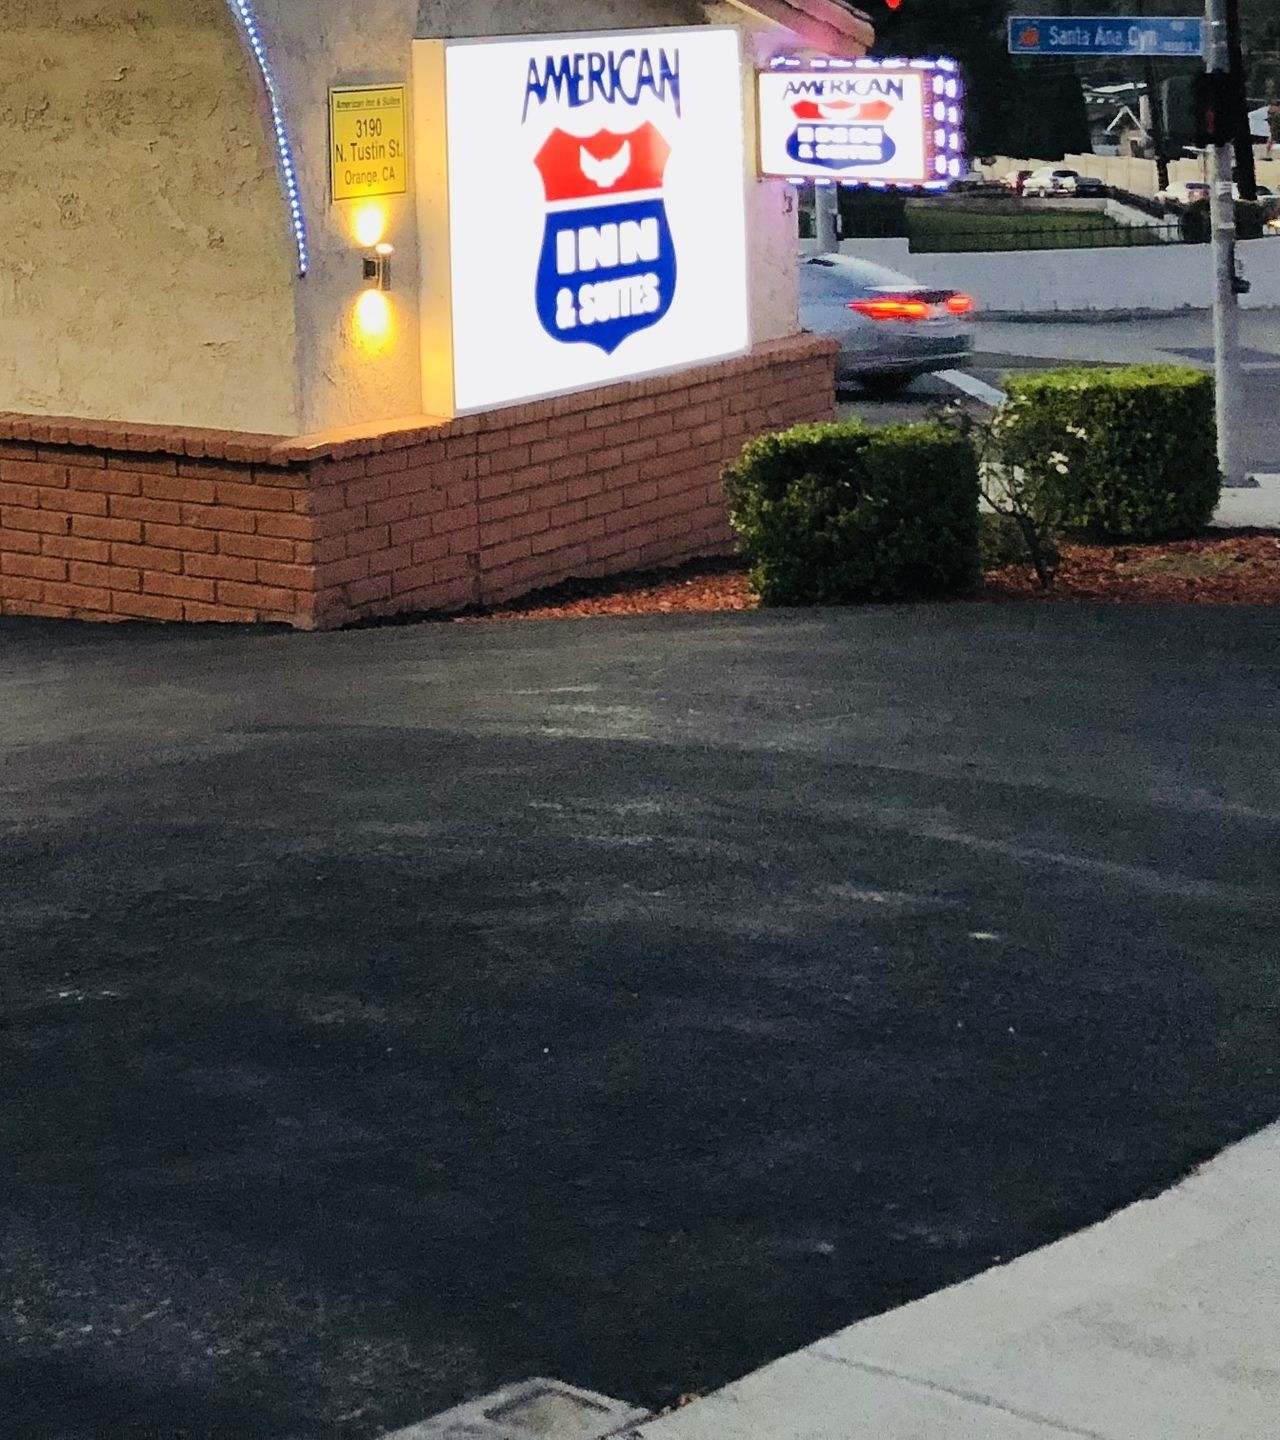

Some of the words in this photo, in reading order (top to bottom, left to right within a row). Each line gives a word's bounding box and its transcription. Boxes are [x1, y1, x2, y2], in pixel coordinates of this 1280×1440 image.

[1048, 25, 1090, 47] Santa
[1094, 25, 1123, 47] Ana
[521, 47, 681, 125] AMERICAN
[782, 78, 904, 101] AMERICAN
[355, 118, 382, 138] 3190
[335, 144, 347, 163] N.
[350, 141, 385, 162] Tustin
[388, 138, 403, 159] St.
[344, 169, 380, 187] Orange,
[382, 166, 396, 182] CA
[556, 217, 660, 275] INN
[556, 286, 577, 330] &
[577, 272, 661, 326] SUITES
